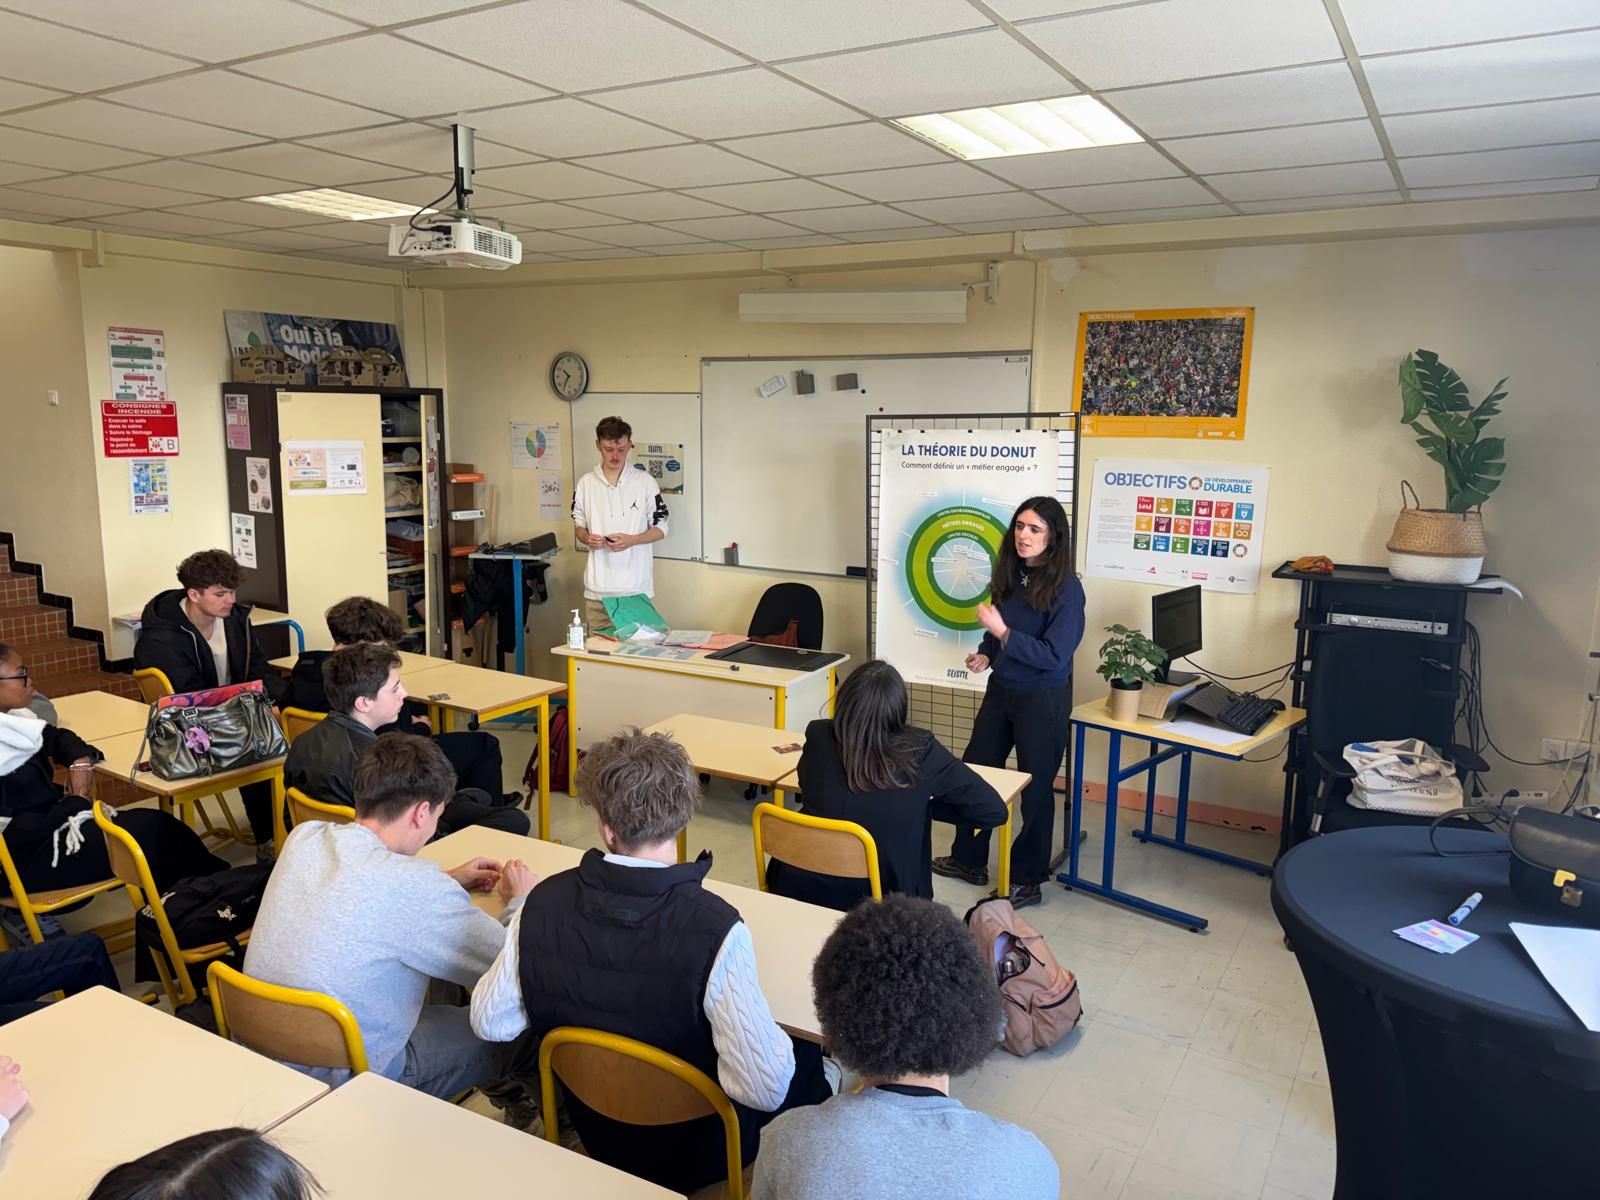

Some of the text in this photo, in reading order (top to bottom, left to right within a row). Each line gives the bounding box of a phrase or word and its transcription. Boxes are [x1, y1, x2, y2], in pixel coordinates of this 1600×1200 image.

[279, 324, 343, 347] Oui à la
[167, 439, 175, 450] B
[901, 442, 1037, 458] LA THÉORIE DU DONUT
[901, 461, 932, 469] Comment
[933, 462, 954, 470] définir
[971, 463, 994, 471] métier
[995, 464, 1025, 473] engagé
[1104, 471, 1188, 490] OBJECTIFS
[1203, 482, 1253, 494] DURABLE
